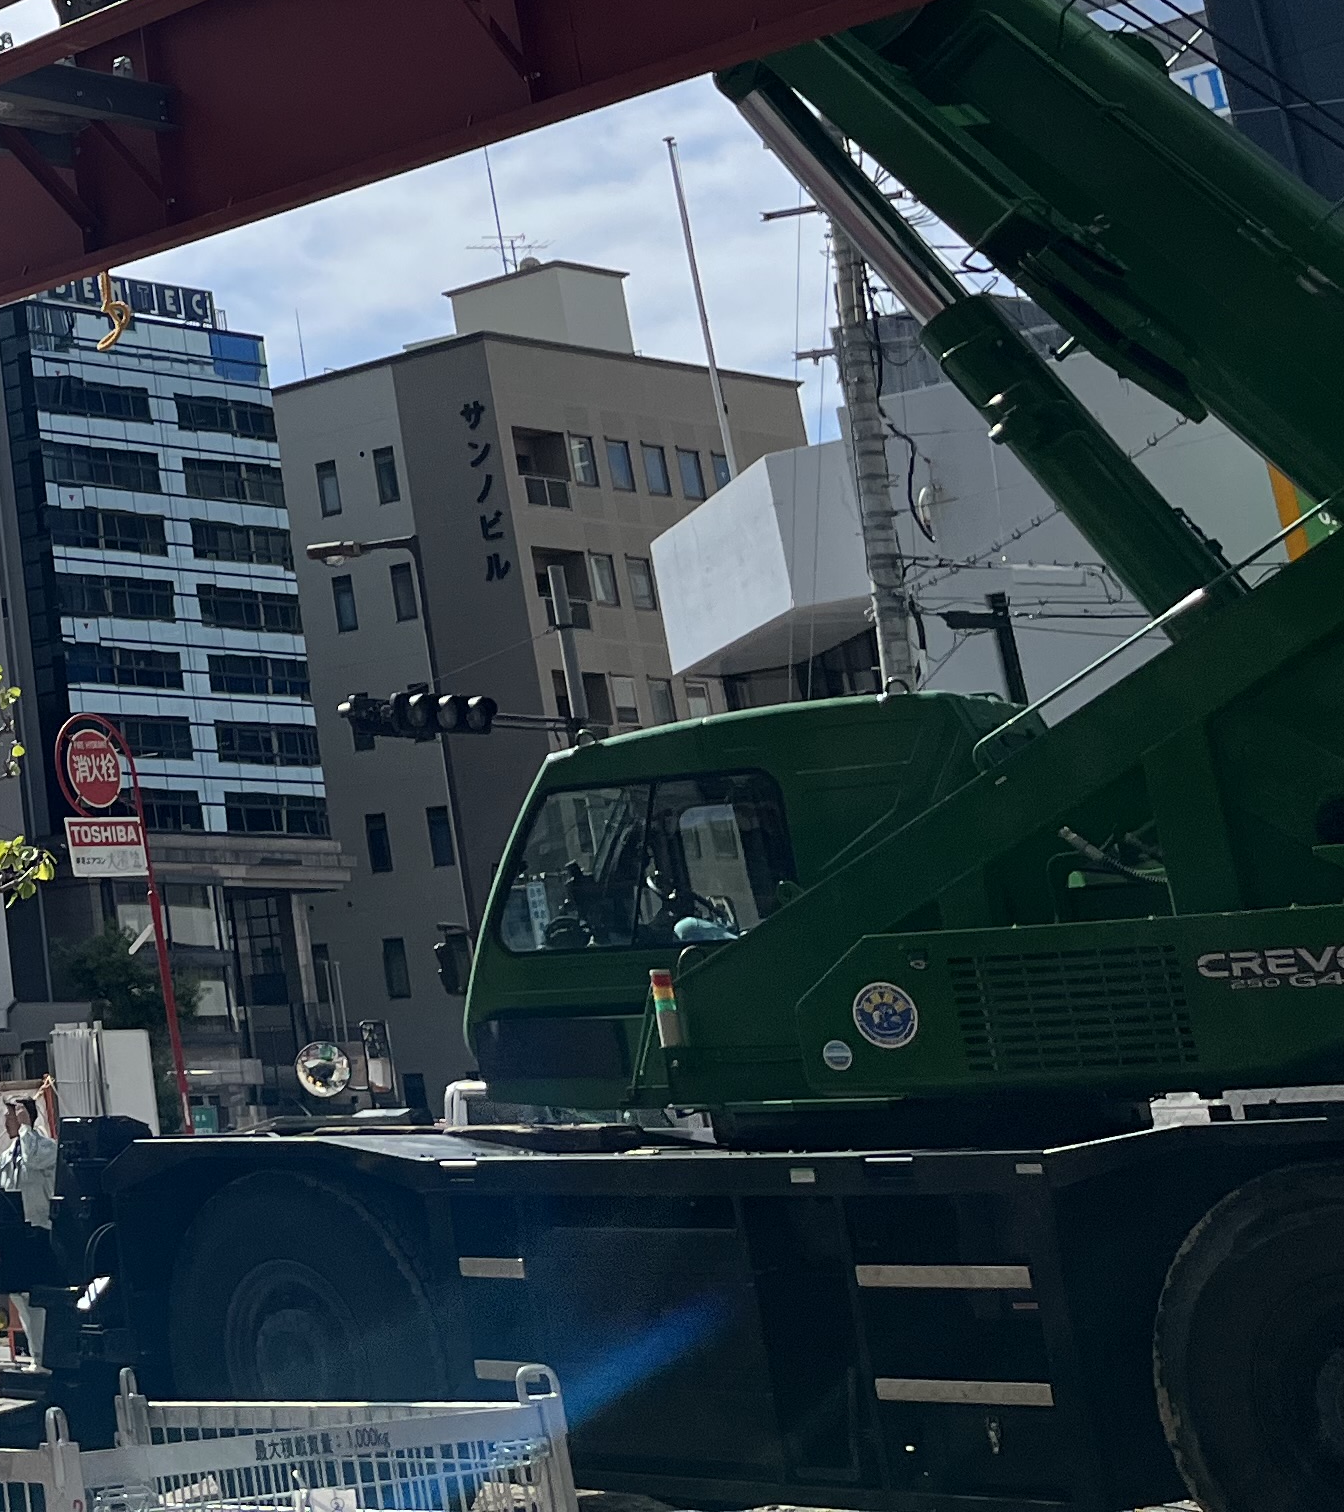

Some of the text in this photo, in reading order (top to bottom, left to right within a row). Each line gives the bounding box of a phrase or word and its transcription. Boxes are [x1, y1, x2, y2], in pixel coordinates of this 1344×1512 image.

[460, 400, 511, 582] サンノビル
[72, 753, 118, 783] 消火栓
[70, 825, 138, 843] TOSHIBA
